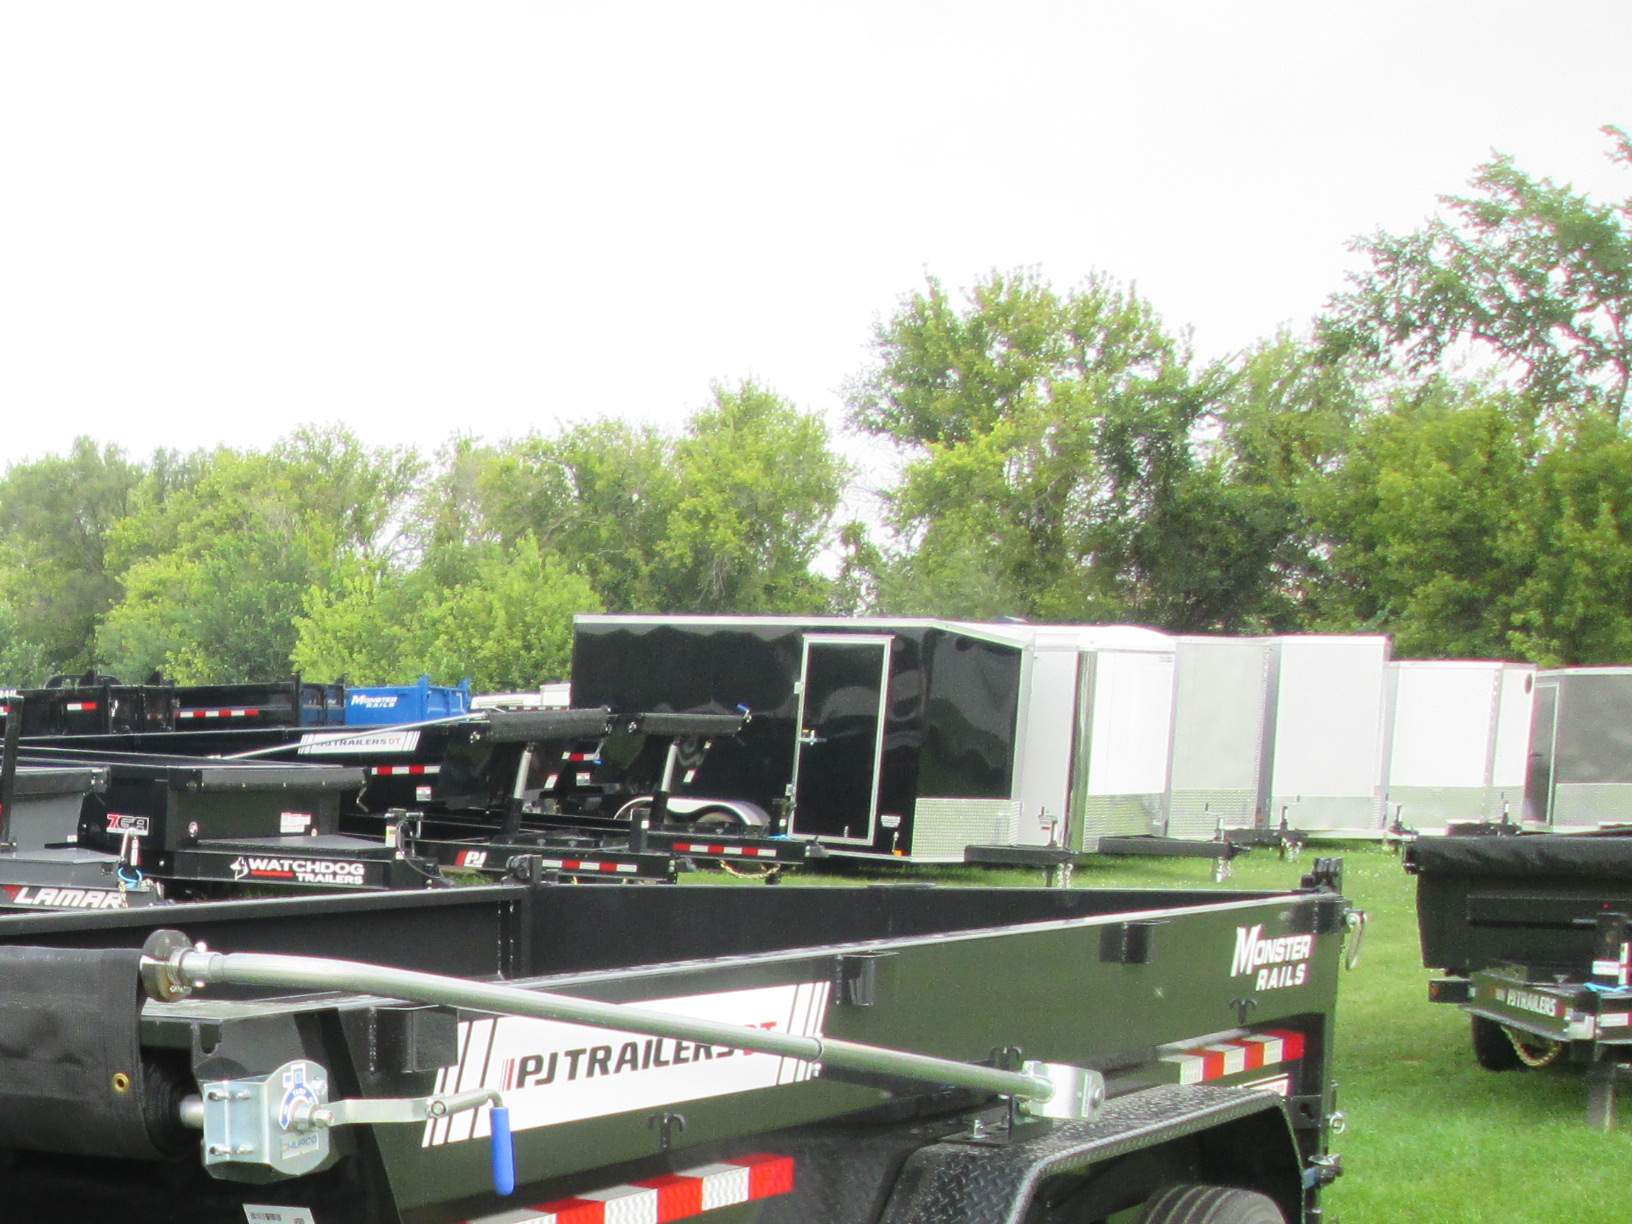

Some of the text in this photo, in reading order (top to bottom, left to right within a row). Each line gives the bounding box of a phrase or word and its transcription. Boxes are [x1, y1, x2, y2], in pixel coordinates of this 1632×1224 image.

[351, 695, 397, 705] MONSTER
[248, 858, 365, 875] WATCHDOG
[465, 851, 487, 864] PJ
[296, 872, 364, 885] TRAILERS
[13, 886, 127, 909] LAMAR
[1230, 923, 1312, 977] MONSTER
[1255, 963, 1306, 991] RAILS
[516, 1052, 559, 1089] PJ
